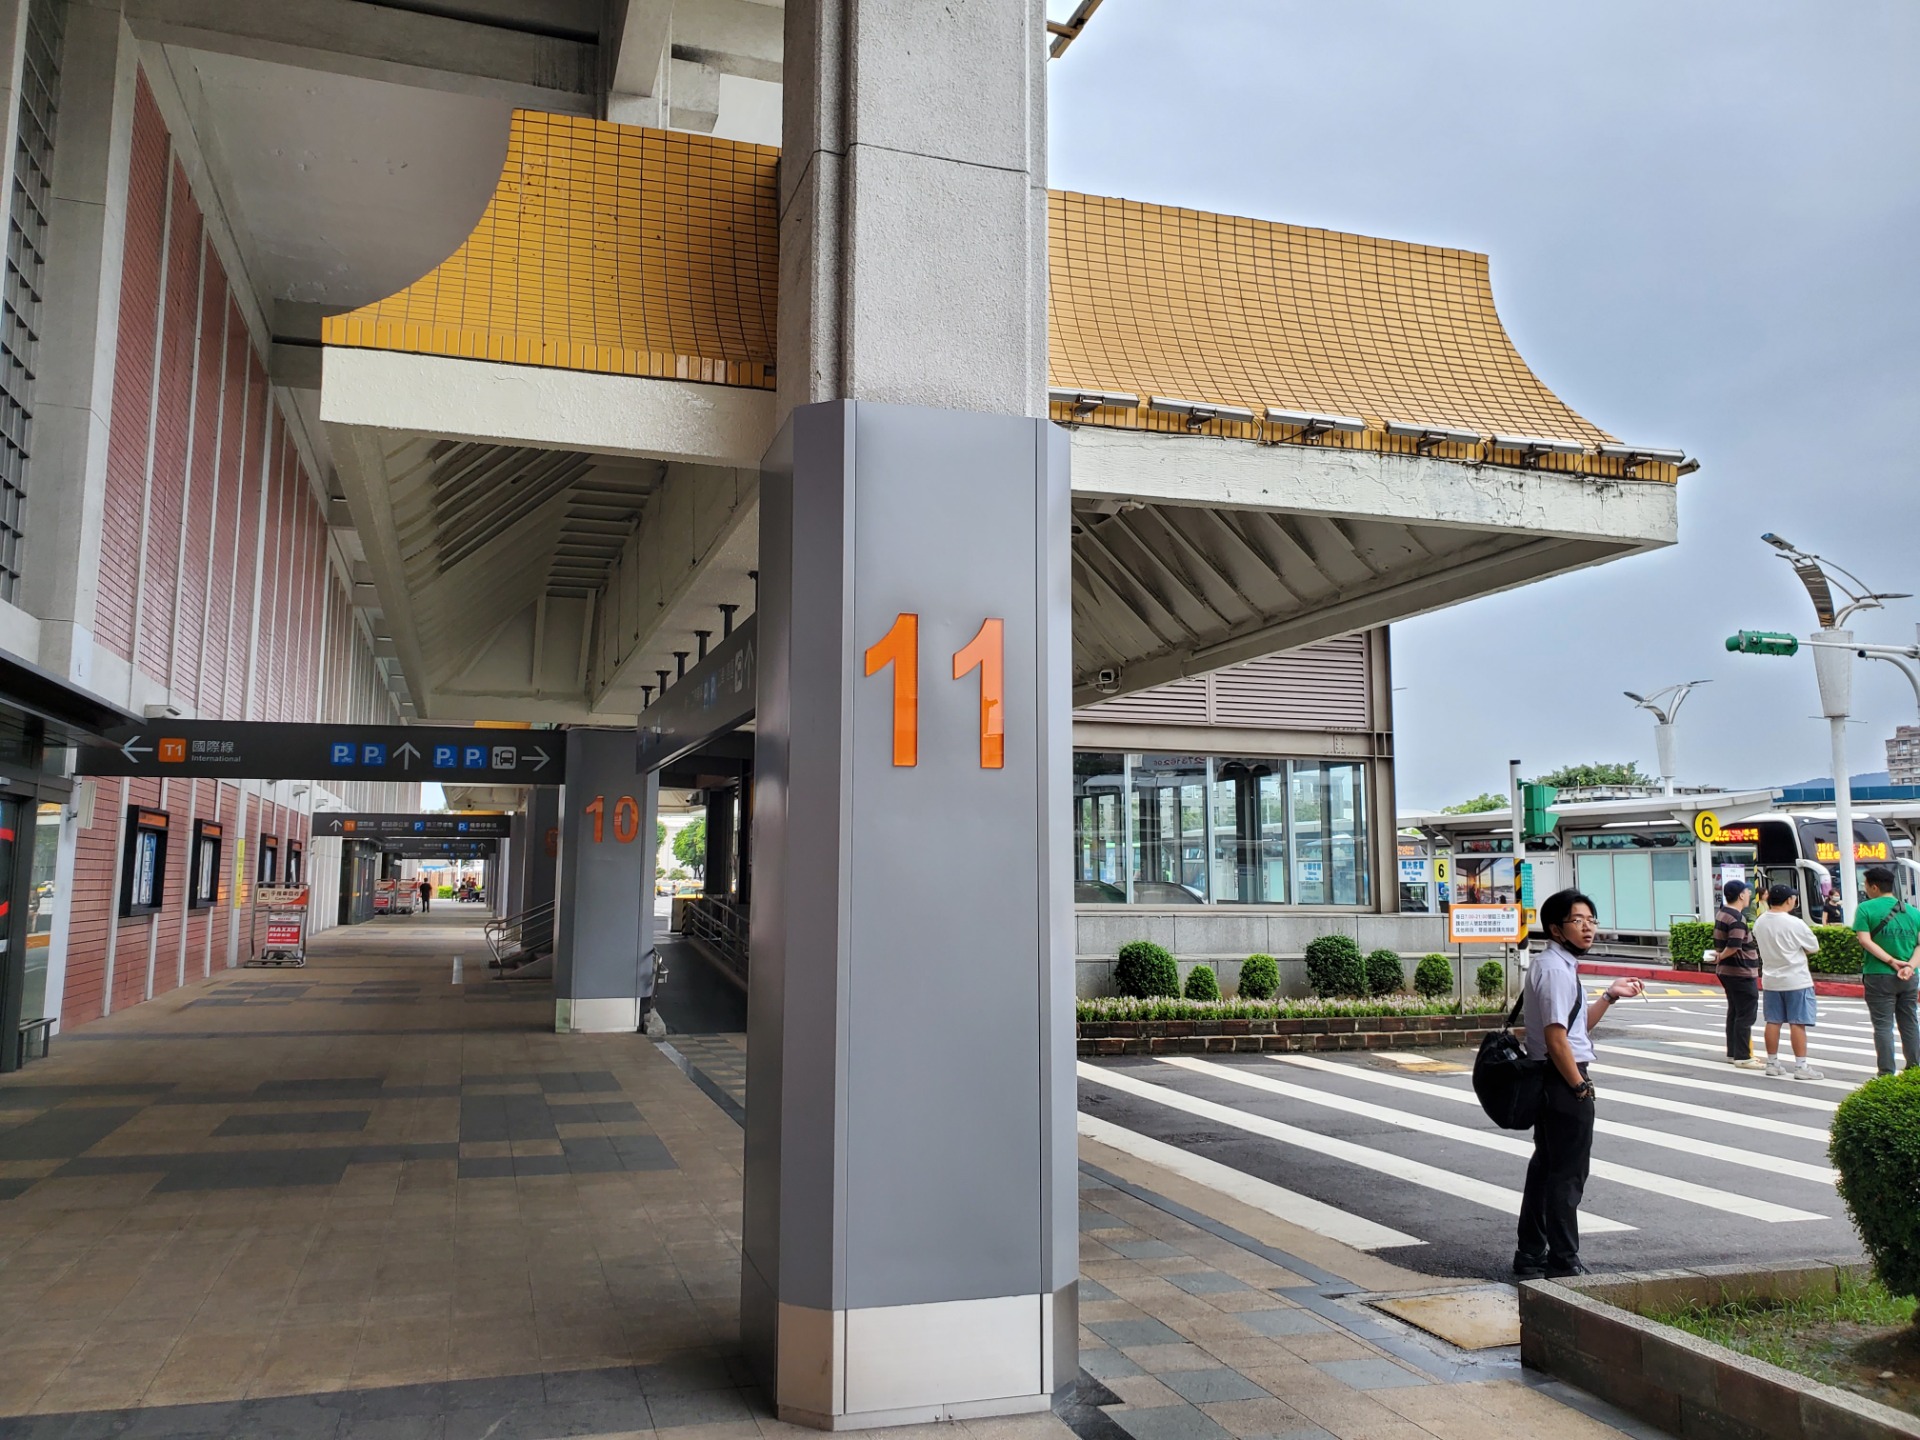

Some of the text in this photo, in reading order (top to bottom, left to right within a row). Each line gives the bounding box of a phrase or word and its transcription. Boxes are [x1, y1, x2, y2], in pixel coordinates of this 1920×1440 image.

[864, 612, 1005, 769] 11
[165, 744, 183, 757] T1
[192, 740, 234, 753] 國際線
[191, 755, 241, 763] International
[585, 795, 639, 844] 10
[1702, 816, 1713, 838] 6
[1438, 863, 1445, 878] 6
